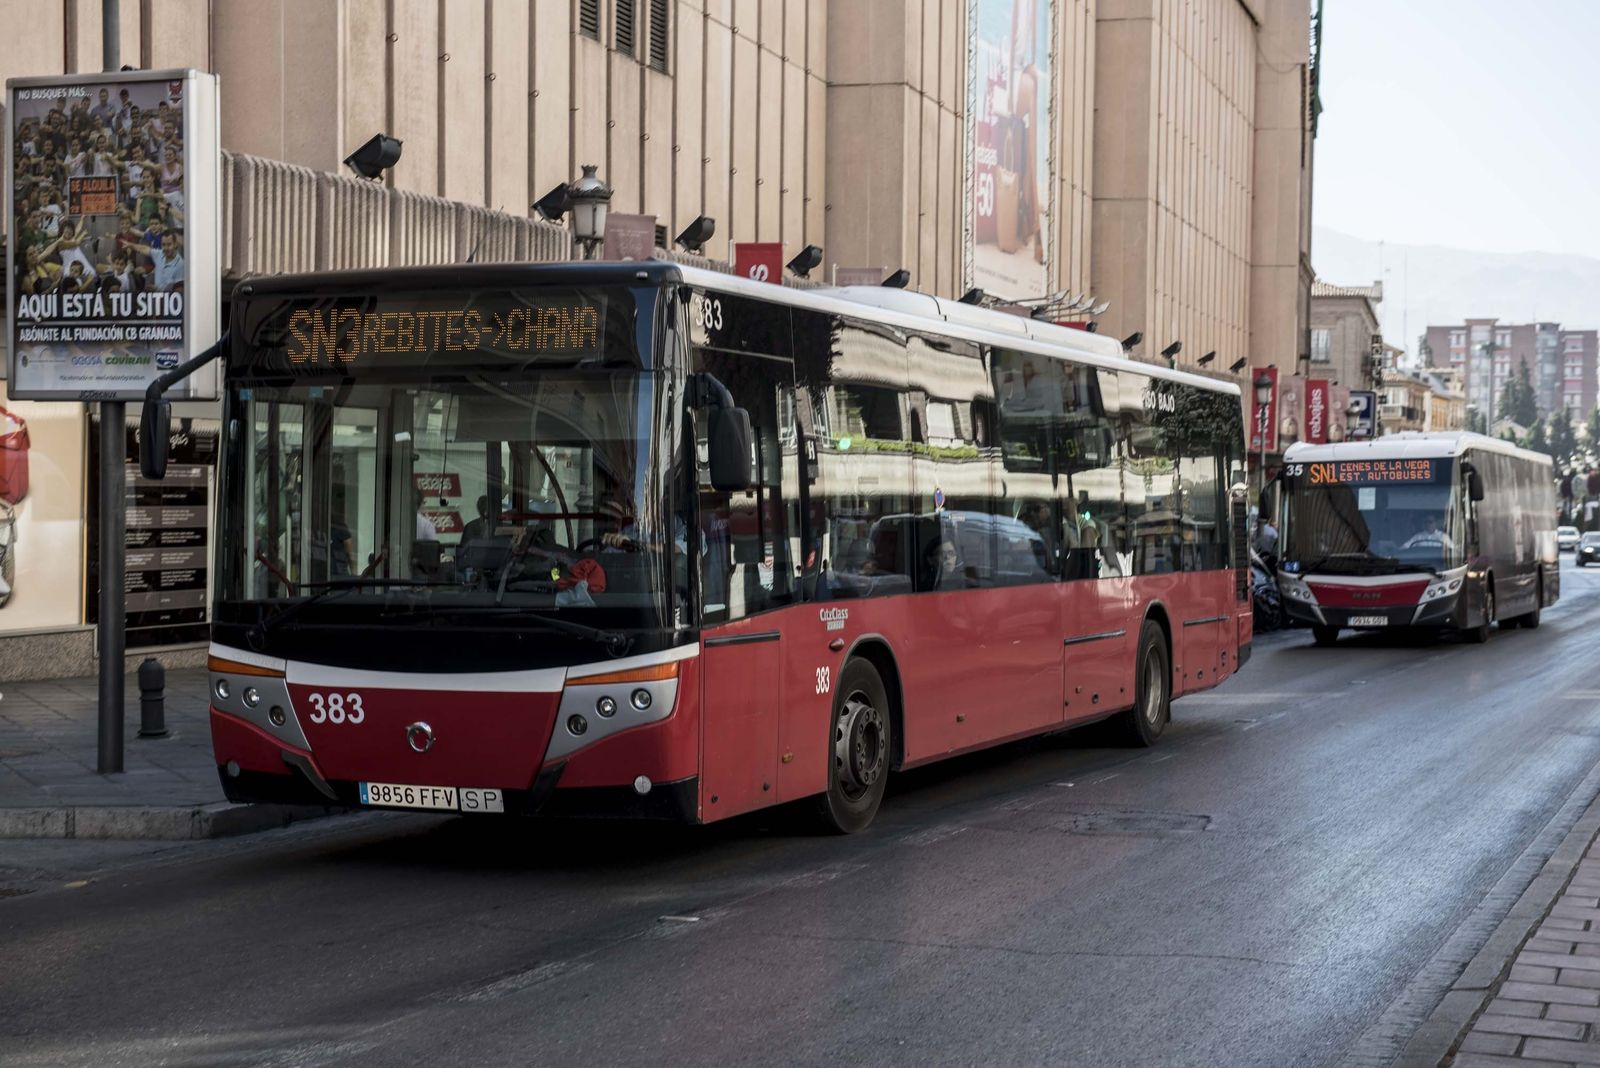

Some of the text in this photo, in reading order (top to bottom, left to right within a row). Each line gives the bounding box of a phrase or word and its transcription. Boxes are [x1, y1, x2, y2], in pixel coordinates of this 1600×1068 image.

[18, 89, 30, 100] NO
[32, 87, 67, 100] BUSQUES
[17, 287, 183, 322] AQUÍ ESTÁ TU SITIO
[695, 297, 723, 331] 383
[19, 323, 182, 342] ABÓNATE AL FUNDACIÓN CB GRANADA
[1286, 464, 1303, 477] 35
[1310, 463, 1339, 484] SN1
[1340, 460, 1430, 472] CENES DE LA VEGA
[1340, 470, 1431, 482] EST. AUTOBUSES
[816, 665, 830, 695] 383
[308, 692, 365, 724] 383
